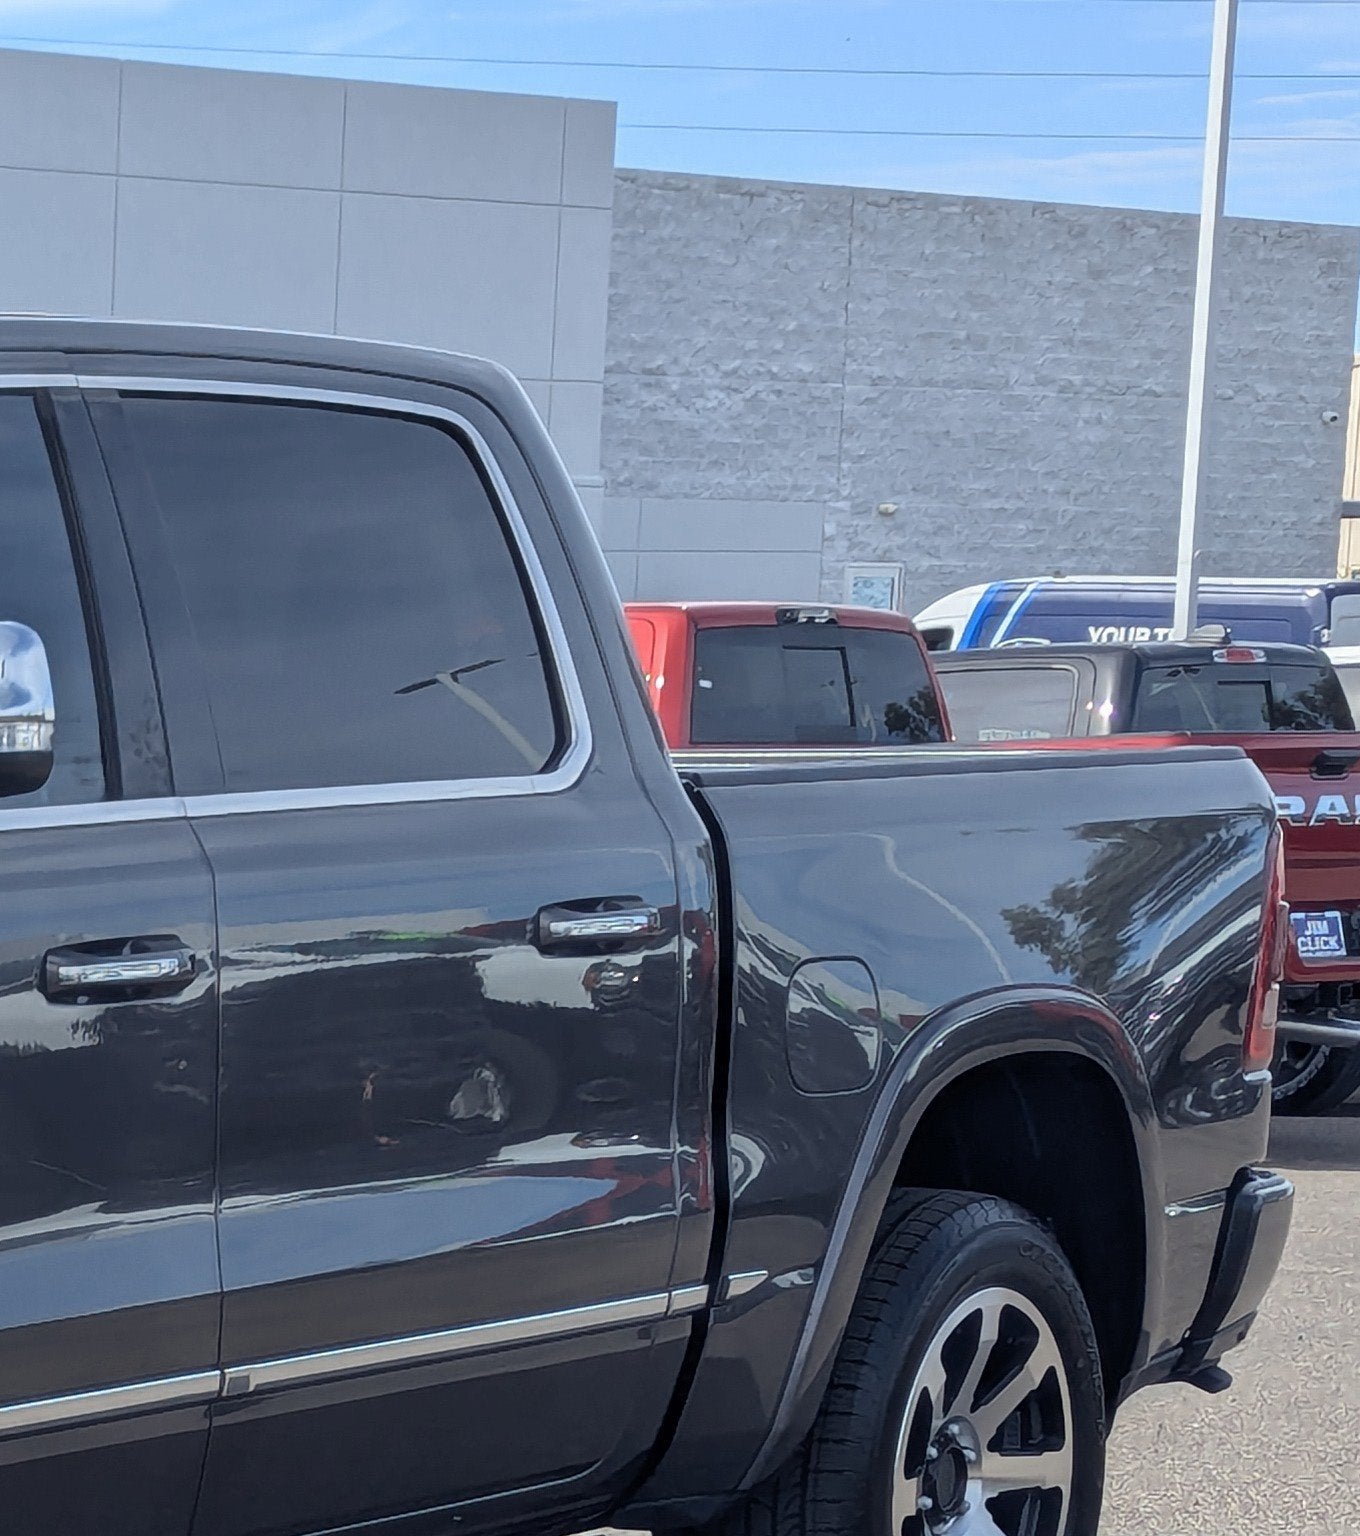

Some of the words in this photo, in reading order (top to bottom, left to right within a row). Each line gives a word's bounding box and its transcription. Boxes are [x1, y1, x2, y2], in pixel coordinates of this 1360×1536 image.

[1087, 626, 1151, 643] YOUR
[1274, 793, 1360, 828] RA
[1304, 920, 1330, 936] JIM
[1298, 935, 1341, 951] CLICK
